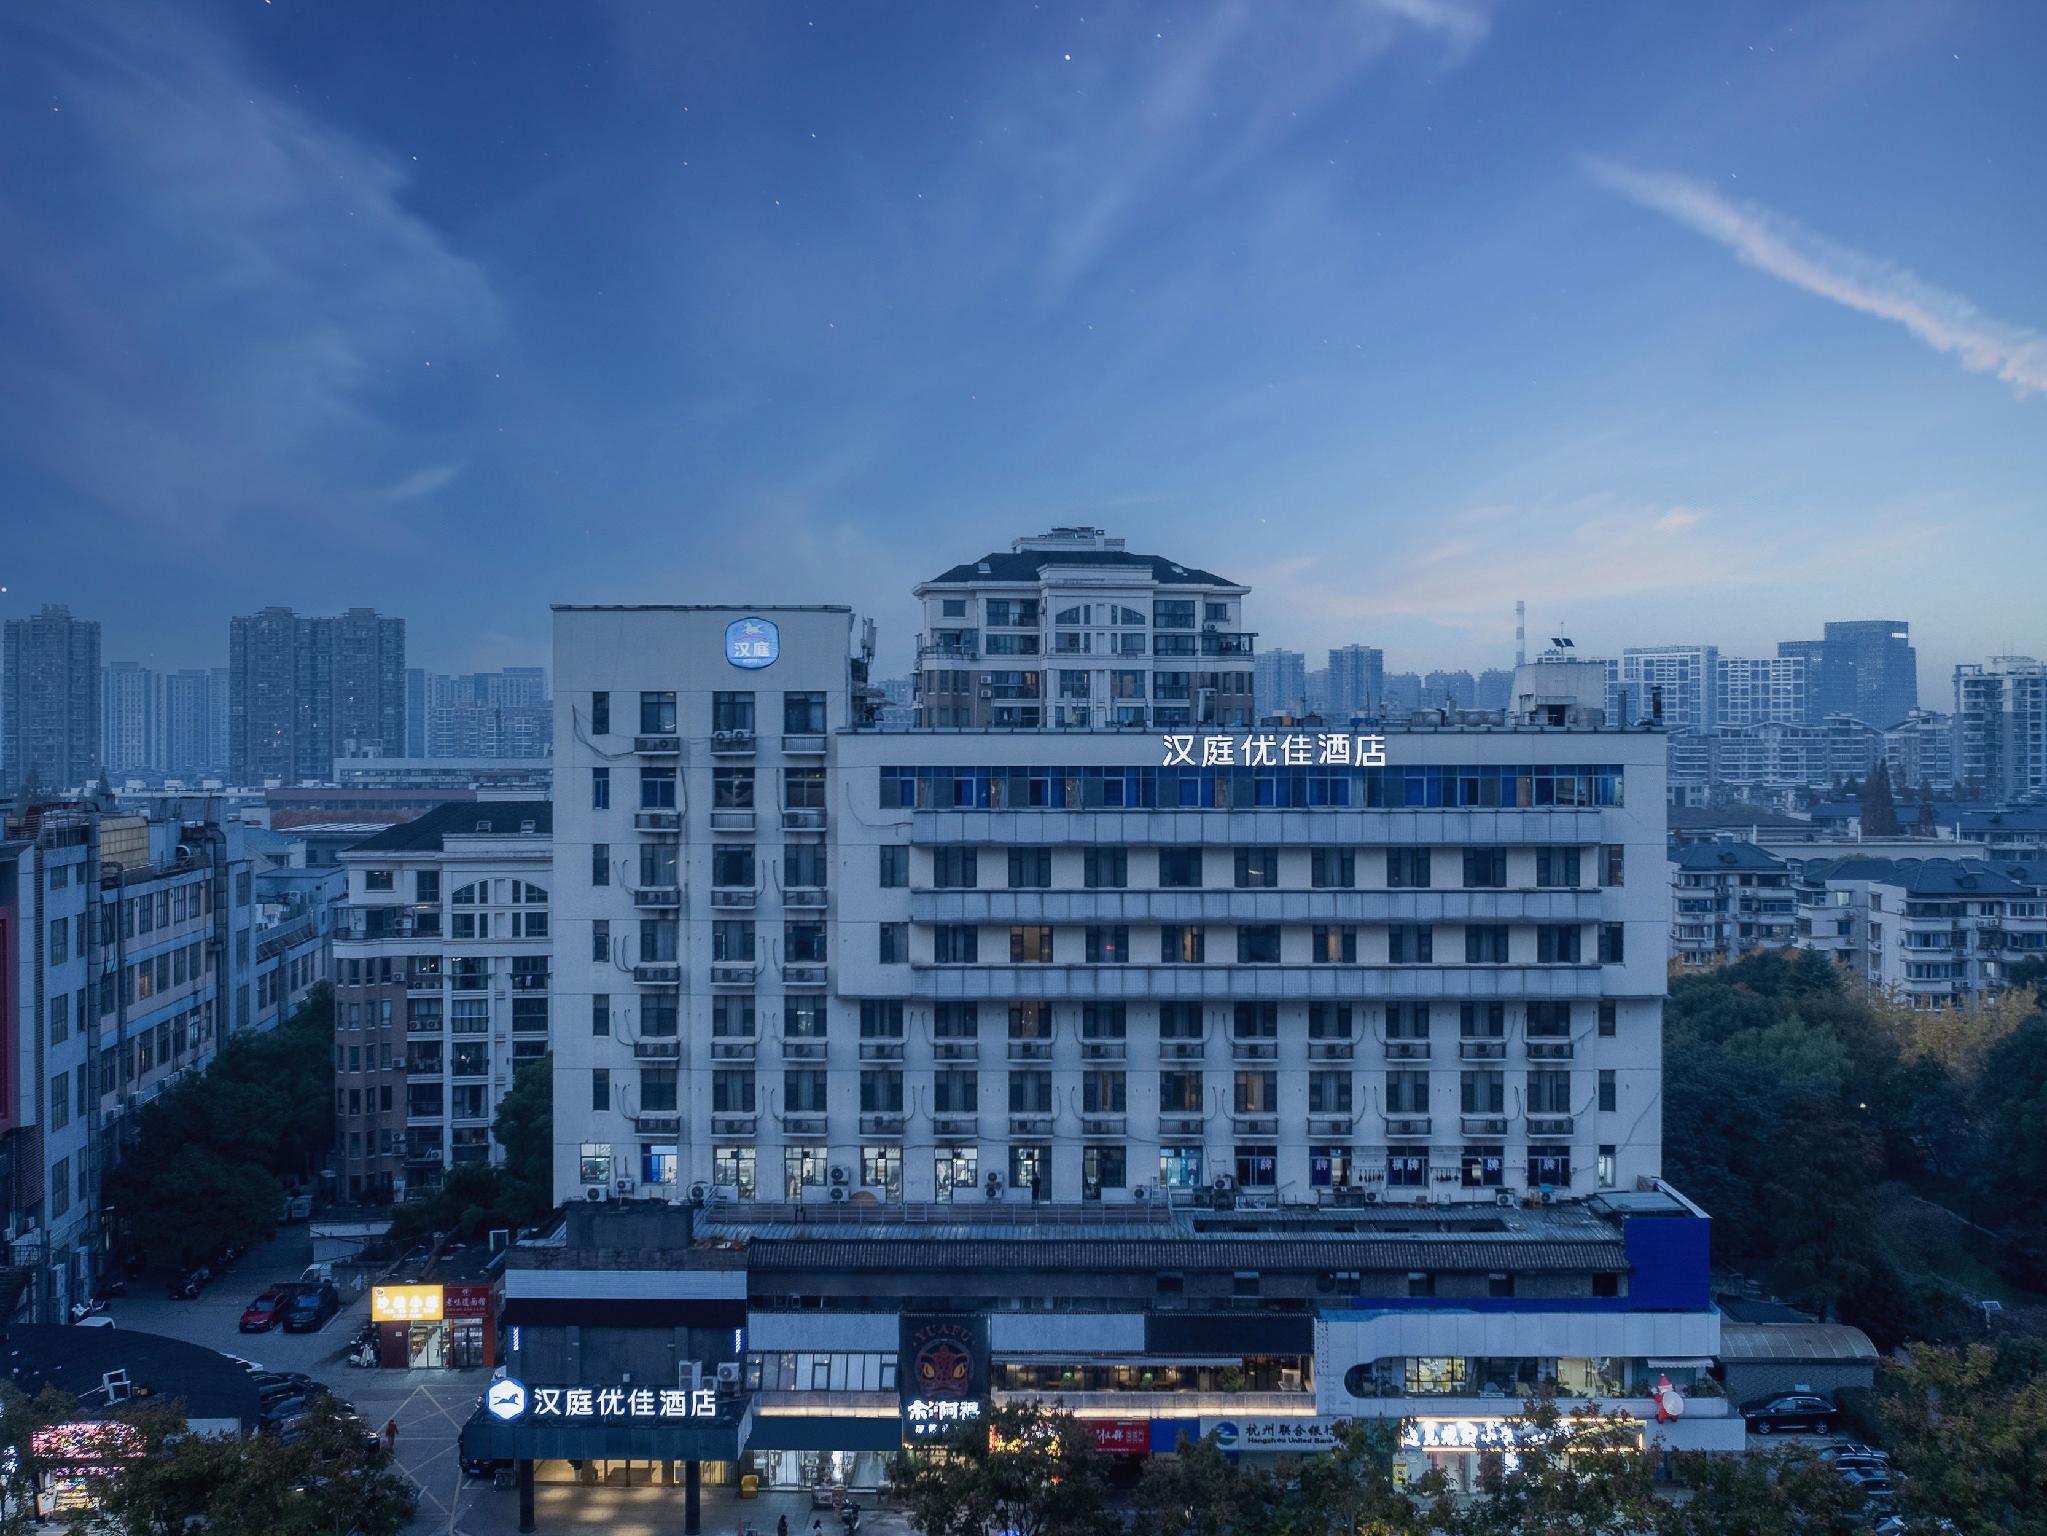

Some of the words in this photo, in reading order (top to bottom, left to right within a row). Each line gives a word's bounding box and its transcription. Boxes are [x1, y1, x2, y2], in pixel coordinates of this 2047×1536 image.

[734, 641, 770, 657] 汉庭
[1162, 733, 1386, 768] 汉庭优佳酒店
[533, 1387, 717, 1417] 汉庭优佳酒店
